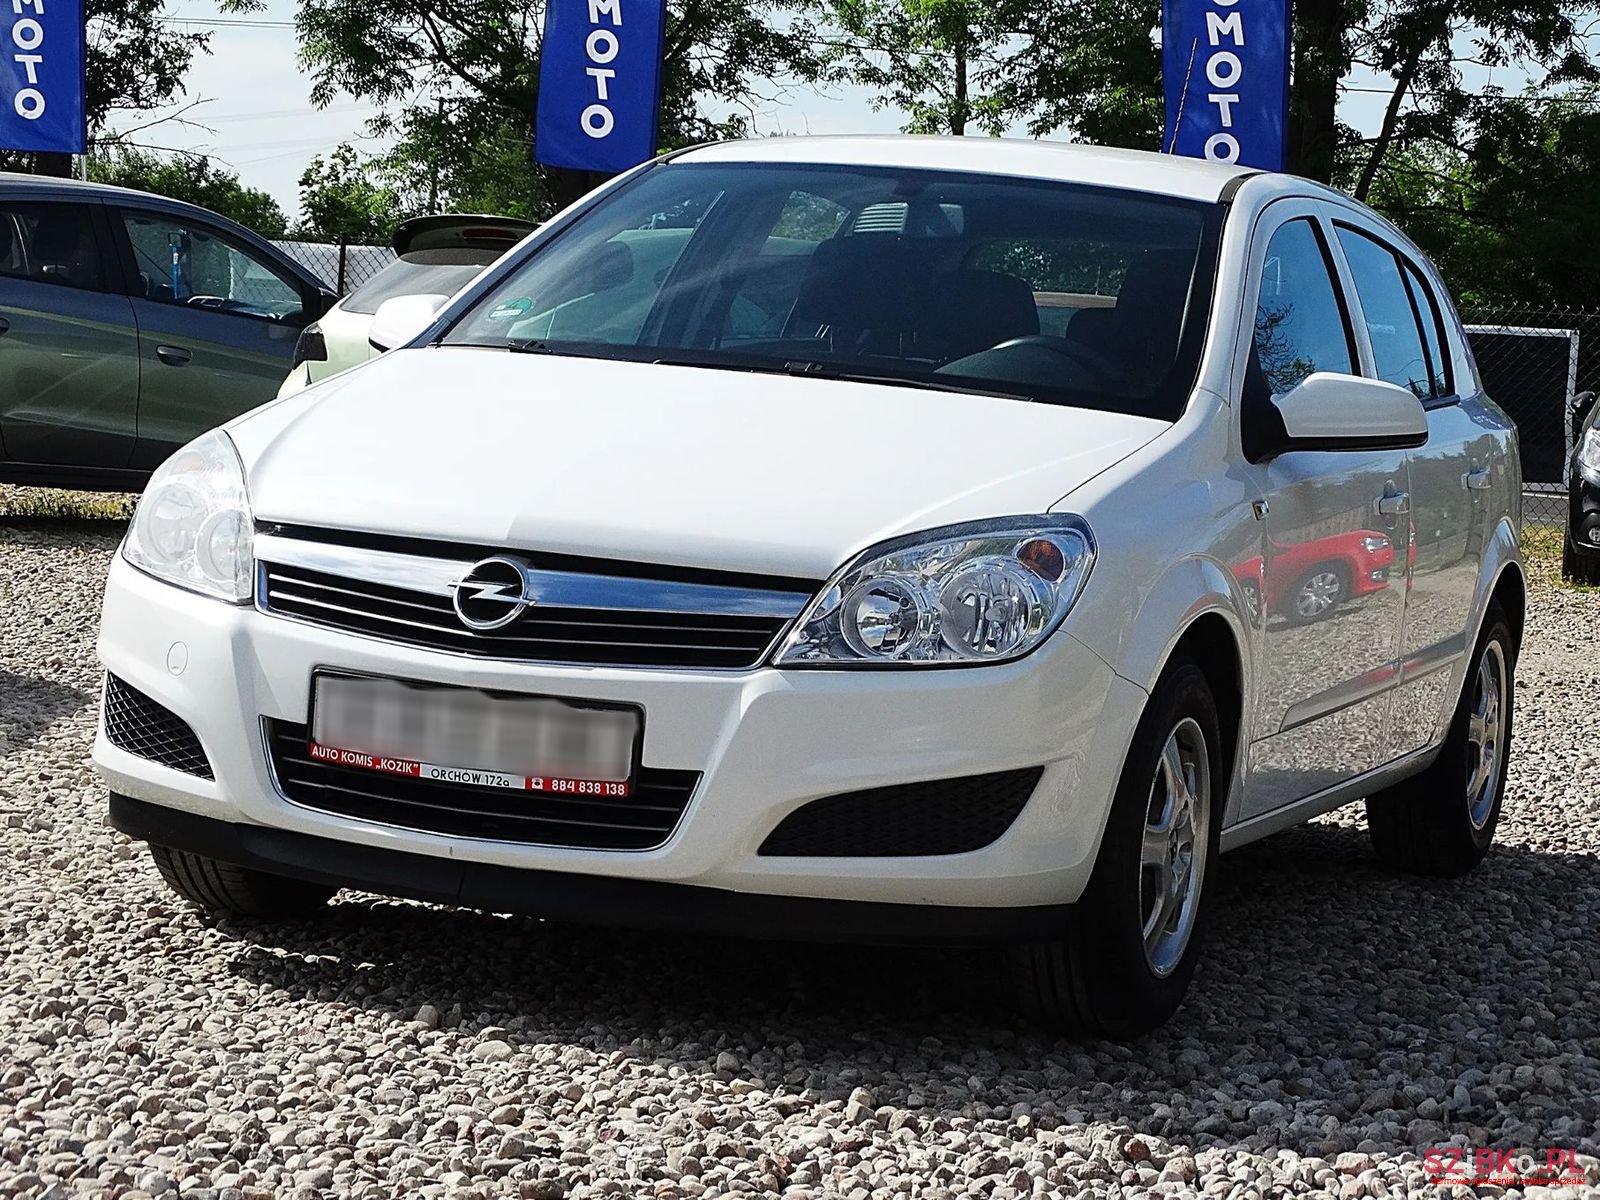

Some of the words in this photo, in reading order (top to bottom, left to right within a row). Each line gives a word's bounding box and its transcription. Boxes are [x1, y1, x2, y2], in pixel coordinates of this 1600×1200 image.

[1205, 0, 1245, 165] MOTO
[312, 745, 338, 760] AUTO
[341, 751, 373, 767] KOMIS
[485, 774, 510, 787] 172a
[551, 779, 575, 792] 884
[579, 781, 601, 794] 838
[605, 783, 625, 796] 138
